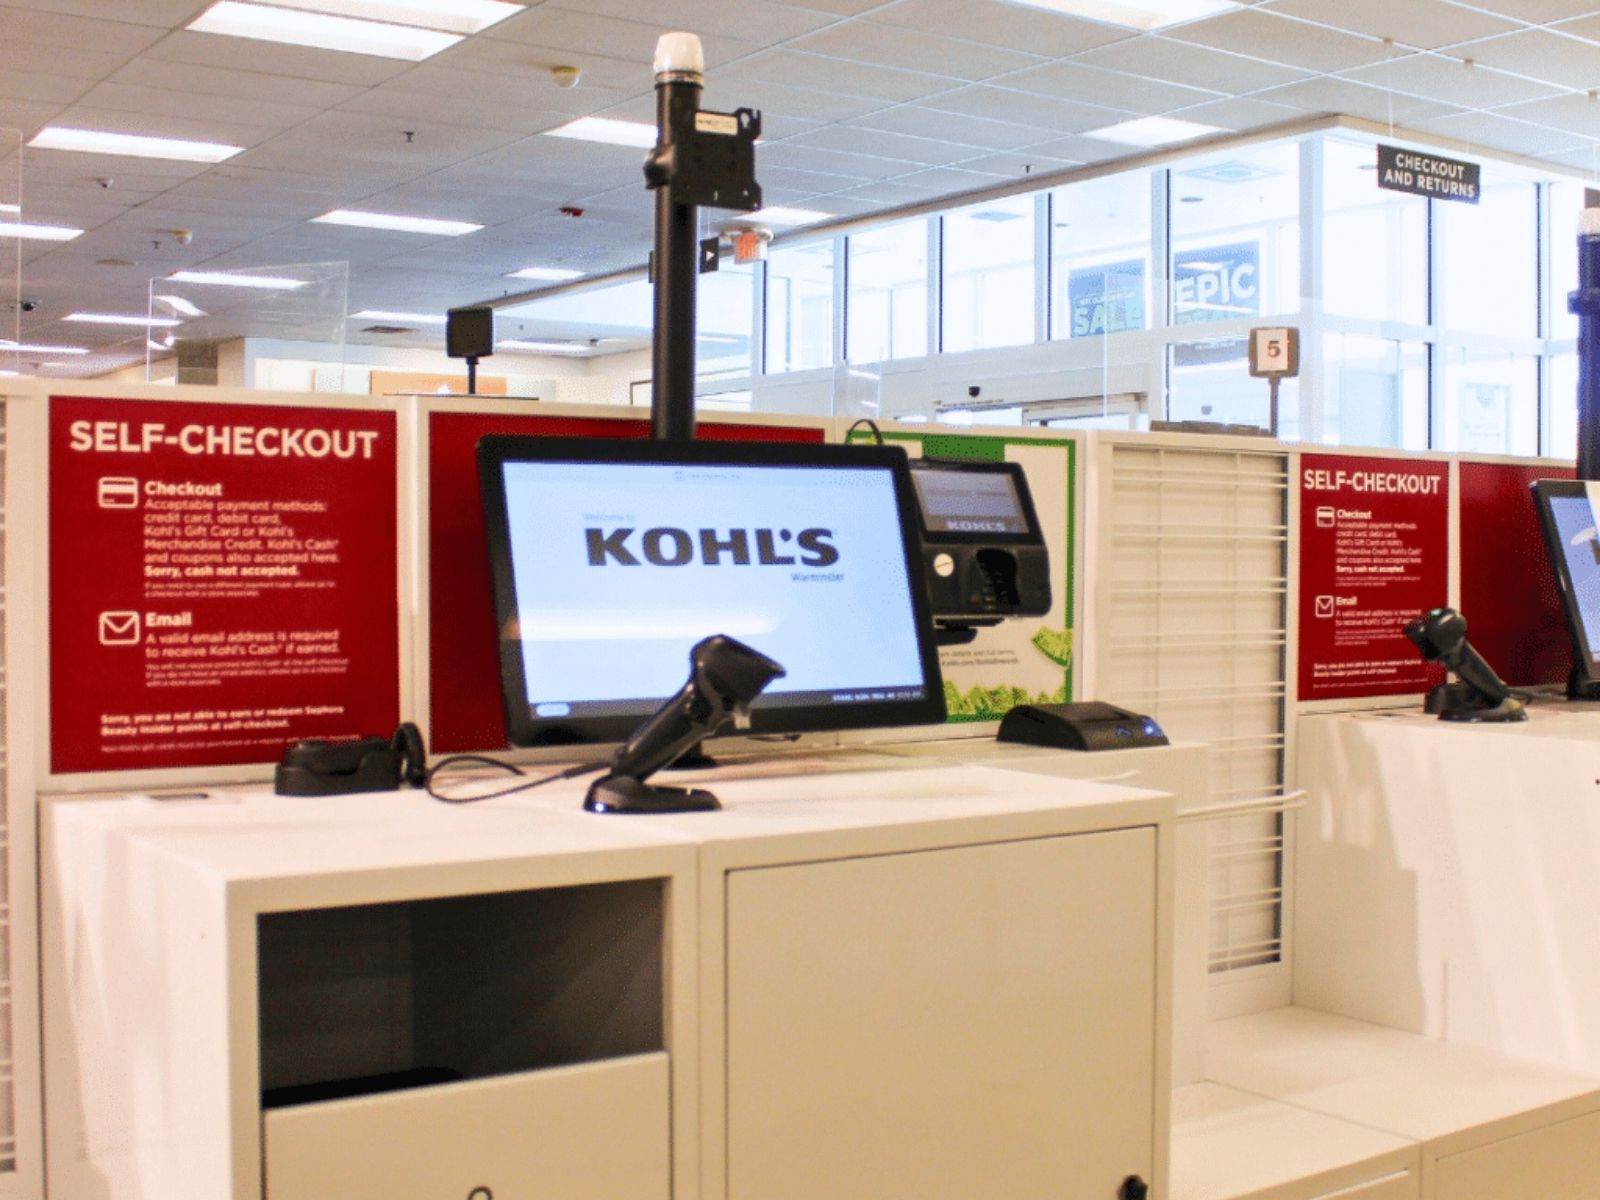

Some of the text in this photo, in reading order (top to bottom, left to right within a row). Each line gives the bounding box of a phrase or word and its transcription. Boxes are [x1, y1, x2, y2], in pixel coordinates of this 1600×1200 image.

[1395, 153, 1464, 179] CHECKOUT
[1384, 168, 1475, 197] AND RETURNS
[1175, 264, 1256, 309] EPIC
[1073, 299, 1142, 336] SALE
[1267, 340, 1281, 358] 5
[69, 421, 379, 459] SELF-CHECKOUT
[145, 480, 223, 496] Checkout
[1304, 469, 1440, 495] SELF-CHECKOUT
[144, 499, 214, 511] Acceptable
[217, 501, 269, 512] payment
[144, 513, 180, 523] credit
[217, 513, 248, 524] debit
[252, 514, 281, 525] card,
[1337, 509, 1372, 519] Checkout
[144, 526, 293, 538] Kohl's Gift Card or Kohl's
[144, 539, 222, 550] Merchandise
[268, 539, 302, 550] Kohl's
[584, 527, 840, 567] KOHL'S
[144, 552, 339, 565] and coupons also accepted here.
[144, 565, 300, 578] Sorry, cash not accepted.
[1336, 596, 1357, 606] Email
[145, 611, 192, 627] Email
[145, 629, 339, 644] A valid email address is required
[145, 647, 159, 658] to
[162, 646, 207, 657] receive
[209, 645, 246, 656] Kohl's
[286, 643, 294, 654] if
[297, 643, 339, 654] earned.
